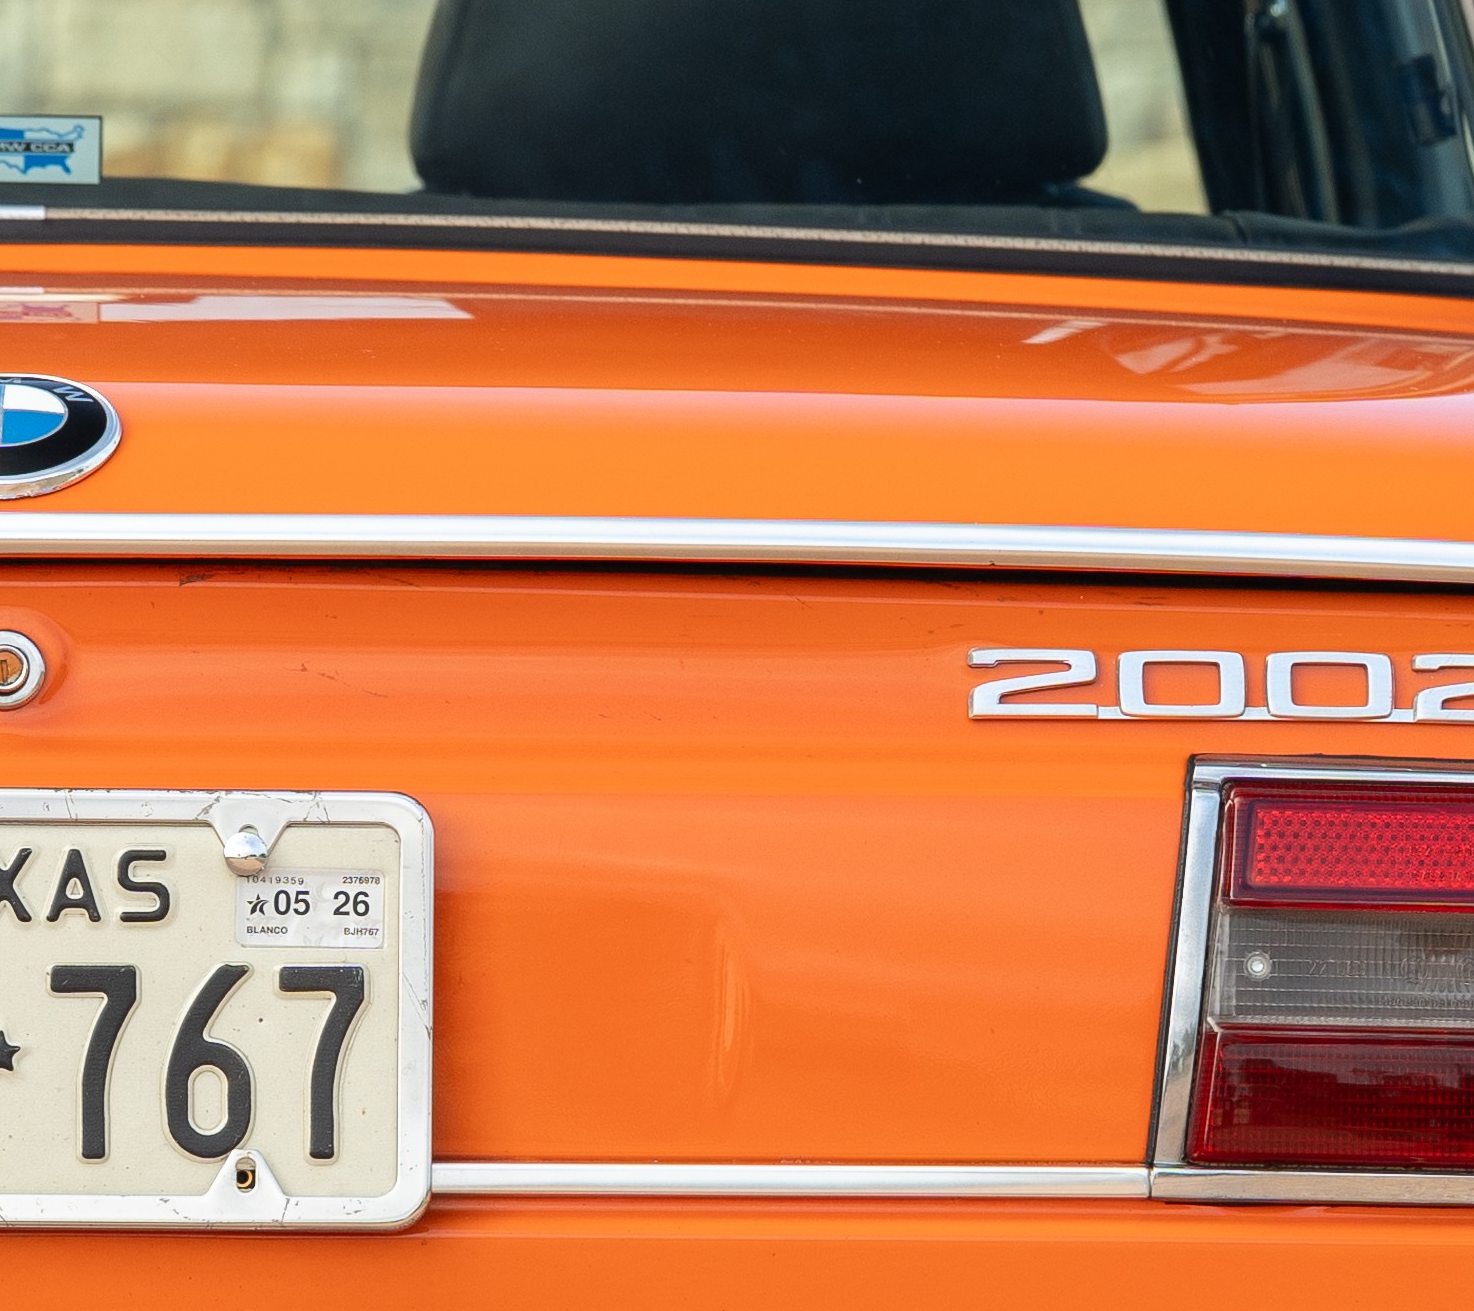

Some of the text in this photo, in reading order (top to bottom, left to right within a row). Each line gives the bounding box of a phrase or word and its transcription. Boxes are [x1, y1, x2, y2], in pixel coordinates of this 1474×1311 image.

[30, 143, 72, 154] CCA
[273, 889, 370, 917] 05 26
[246, 926, 288, 934] BLANCO
[343, 927, 379, 936] BJH767
[50, 964, 366, 1160] 767
